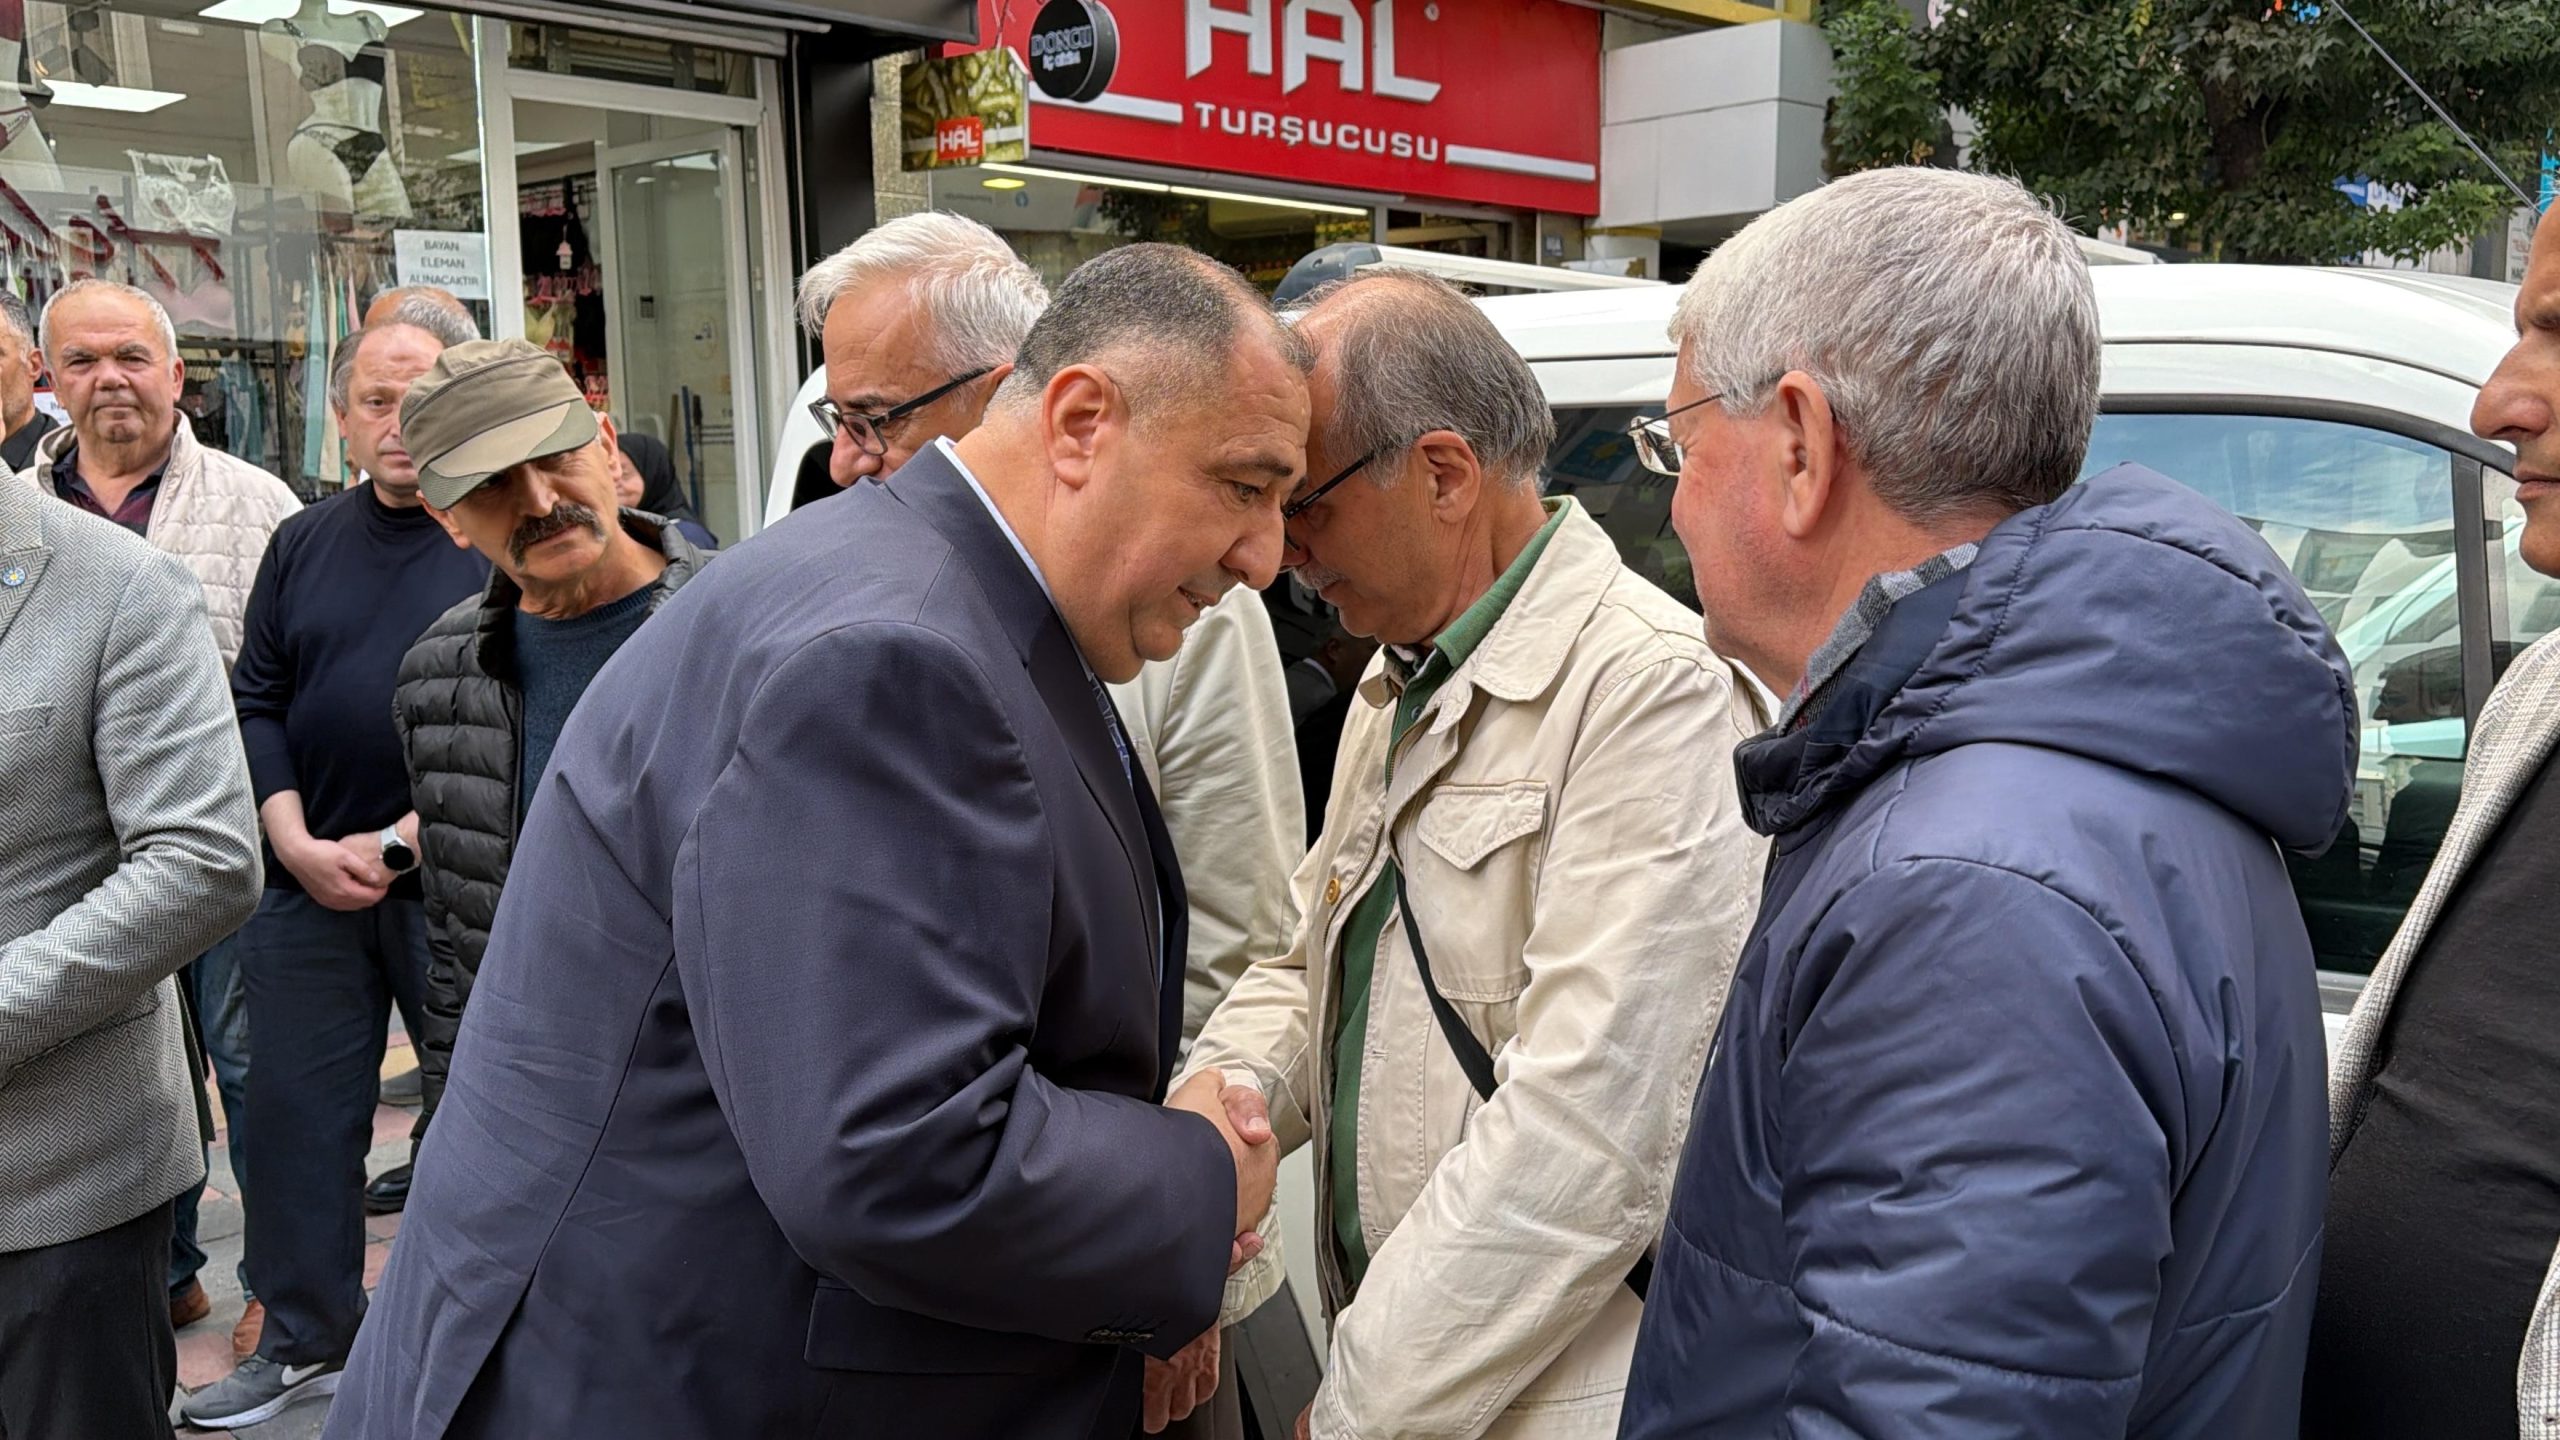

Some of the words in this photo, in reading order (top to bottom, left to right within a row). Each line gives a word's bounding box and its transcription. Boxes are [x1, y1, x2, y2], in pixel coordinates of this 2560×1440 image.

[1030, 25, 1092, 57] DONCU
[1186, 0, 1442, 102] HAL
[1194, 101, 1439, 162] TURŞUCUSU
[424, 240, 460, 252] BAYAN
[420, 257, 466, 269] ELEMAN
[409, 274, 480, 286] ALINACAKTIR
